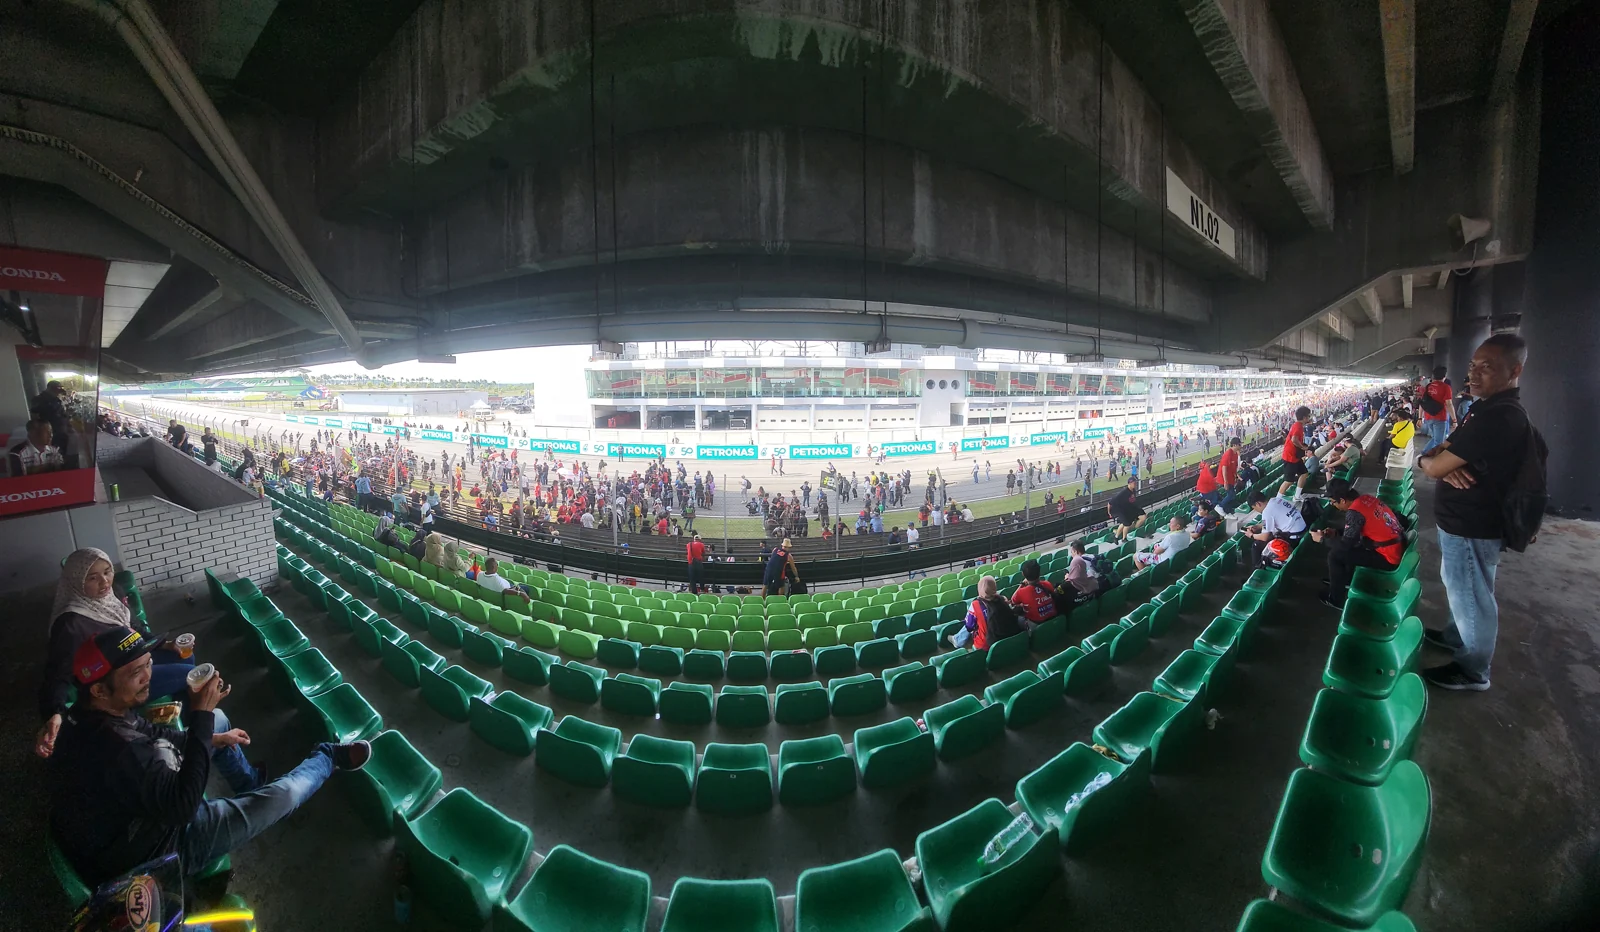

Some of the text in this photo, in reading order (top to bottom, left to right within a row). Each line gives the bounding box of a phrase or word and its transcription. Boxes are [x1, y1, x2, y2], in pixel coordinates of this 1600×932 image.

[1190, 195, 1220, 245] N1.02
[0, 267, 66, 282] ONDA
[533, 441, 578, 452] PETRONAS
[611, 445, 663, 456] PTRONAS
[700, 447, 755, 457] PETRONAS
[792, 447, 848, 457] PETRONAS
[884, 443, 933, 455] PETRONAS
[130, 886, 145, 925] Arai
